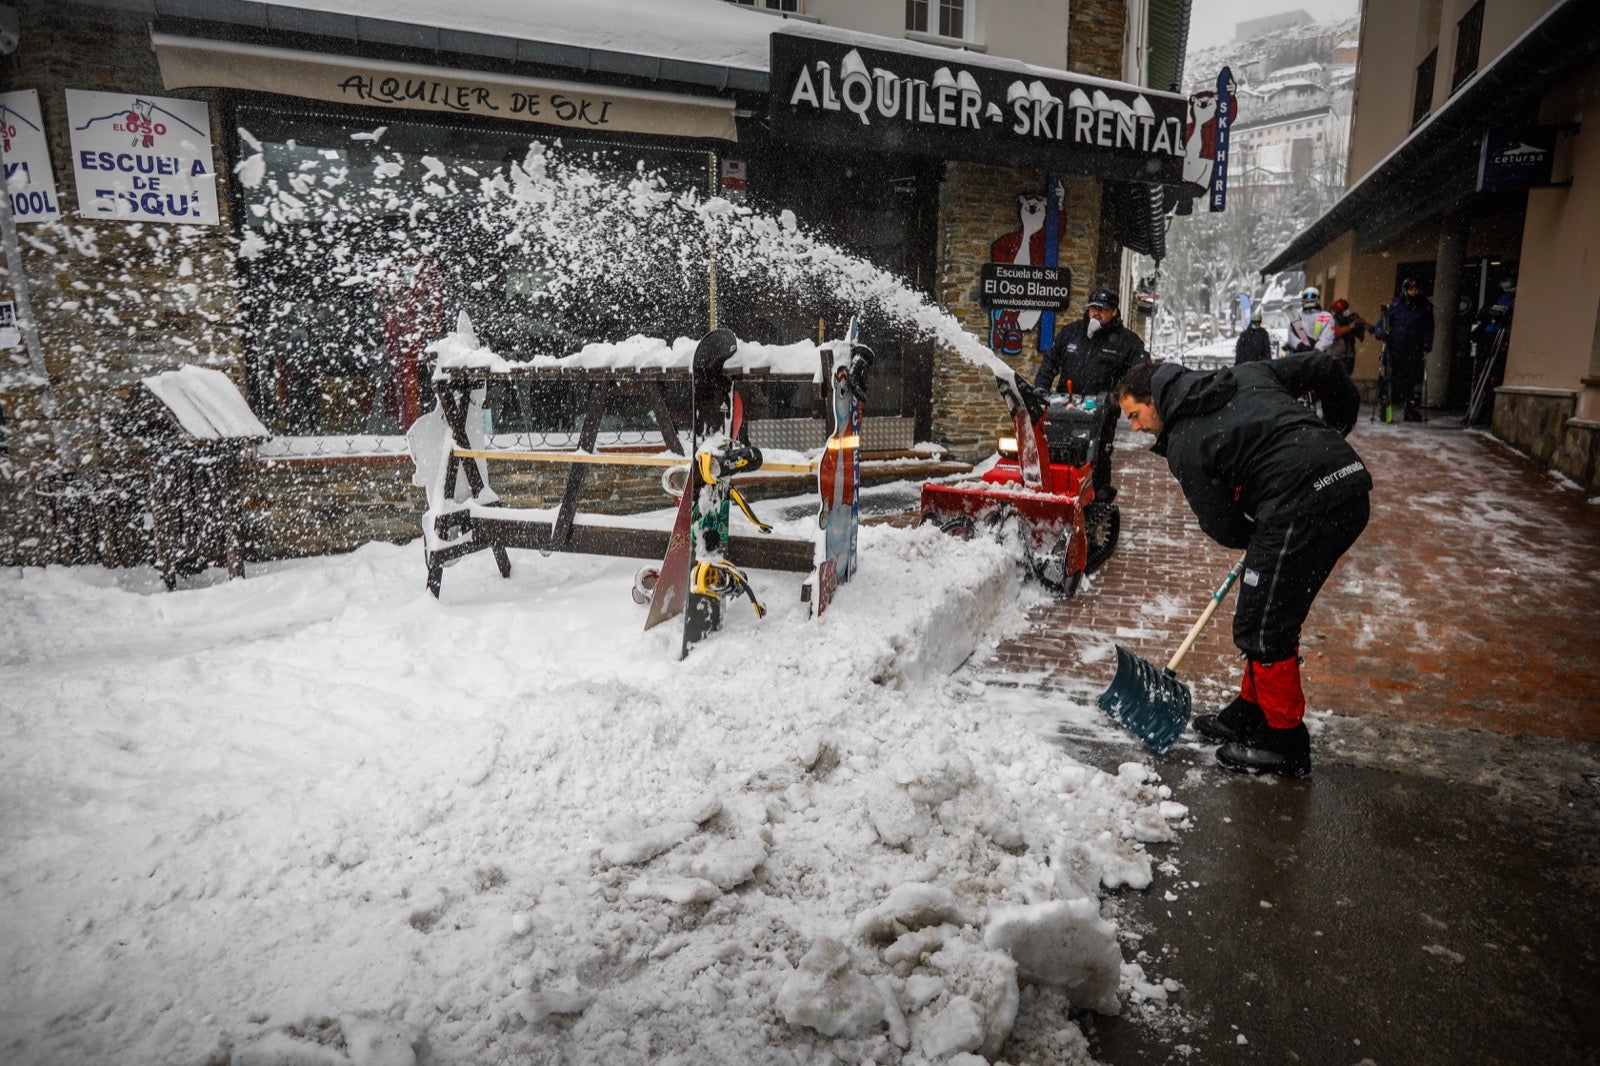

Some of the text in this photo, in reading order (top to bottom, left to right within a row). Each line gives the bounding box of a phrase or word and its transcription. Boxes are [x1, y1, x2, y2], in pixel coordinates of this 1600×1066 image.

[338, 75, 612, 125] ALQUILER DE SKI
[790, 64, 982, 129] ALQUILER
[1013, 98, 1063, 140] SKI
[1075, 106, 1187, 157] RENTAL
[112, 122, 167, 136] EL OSO
[1214, 102, 1228, 205] SKI HIRE
[132, 175, 161, 191] DE
[996, 266, 1059, 280] Escuela de Ski
[985, 279, 1068, 297] El Oso Blanco
[991, 297, 1060, 308] www.elosoblanco.com
